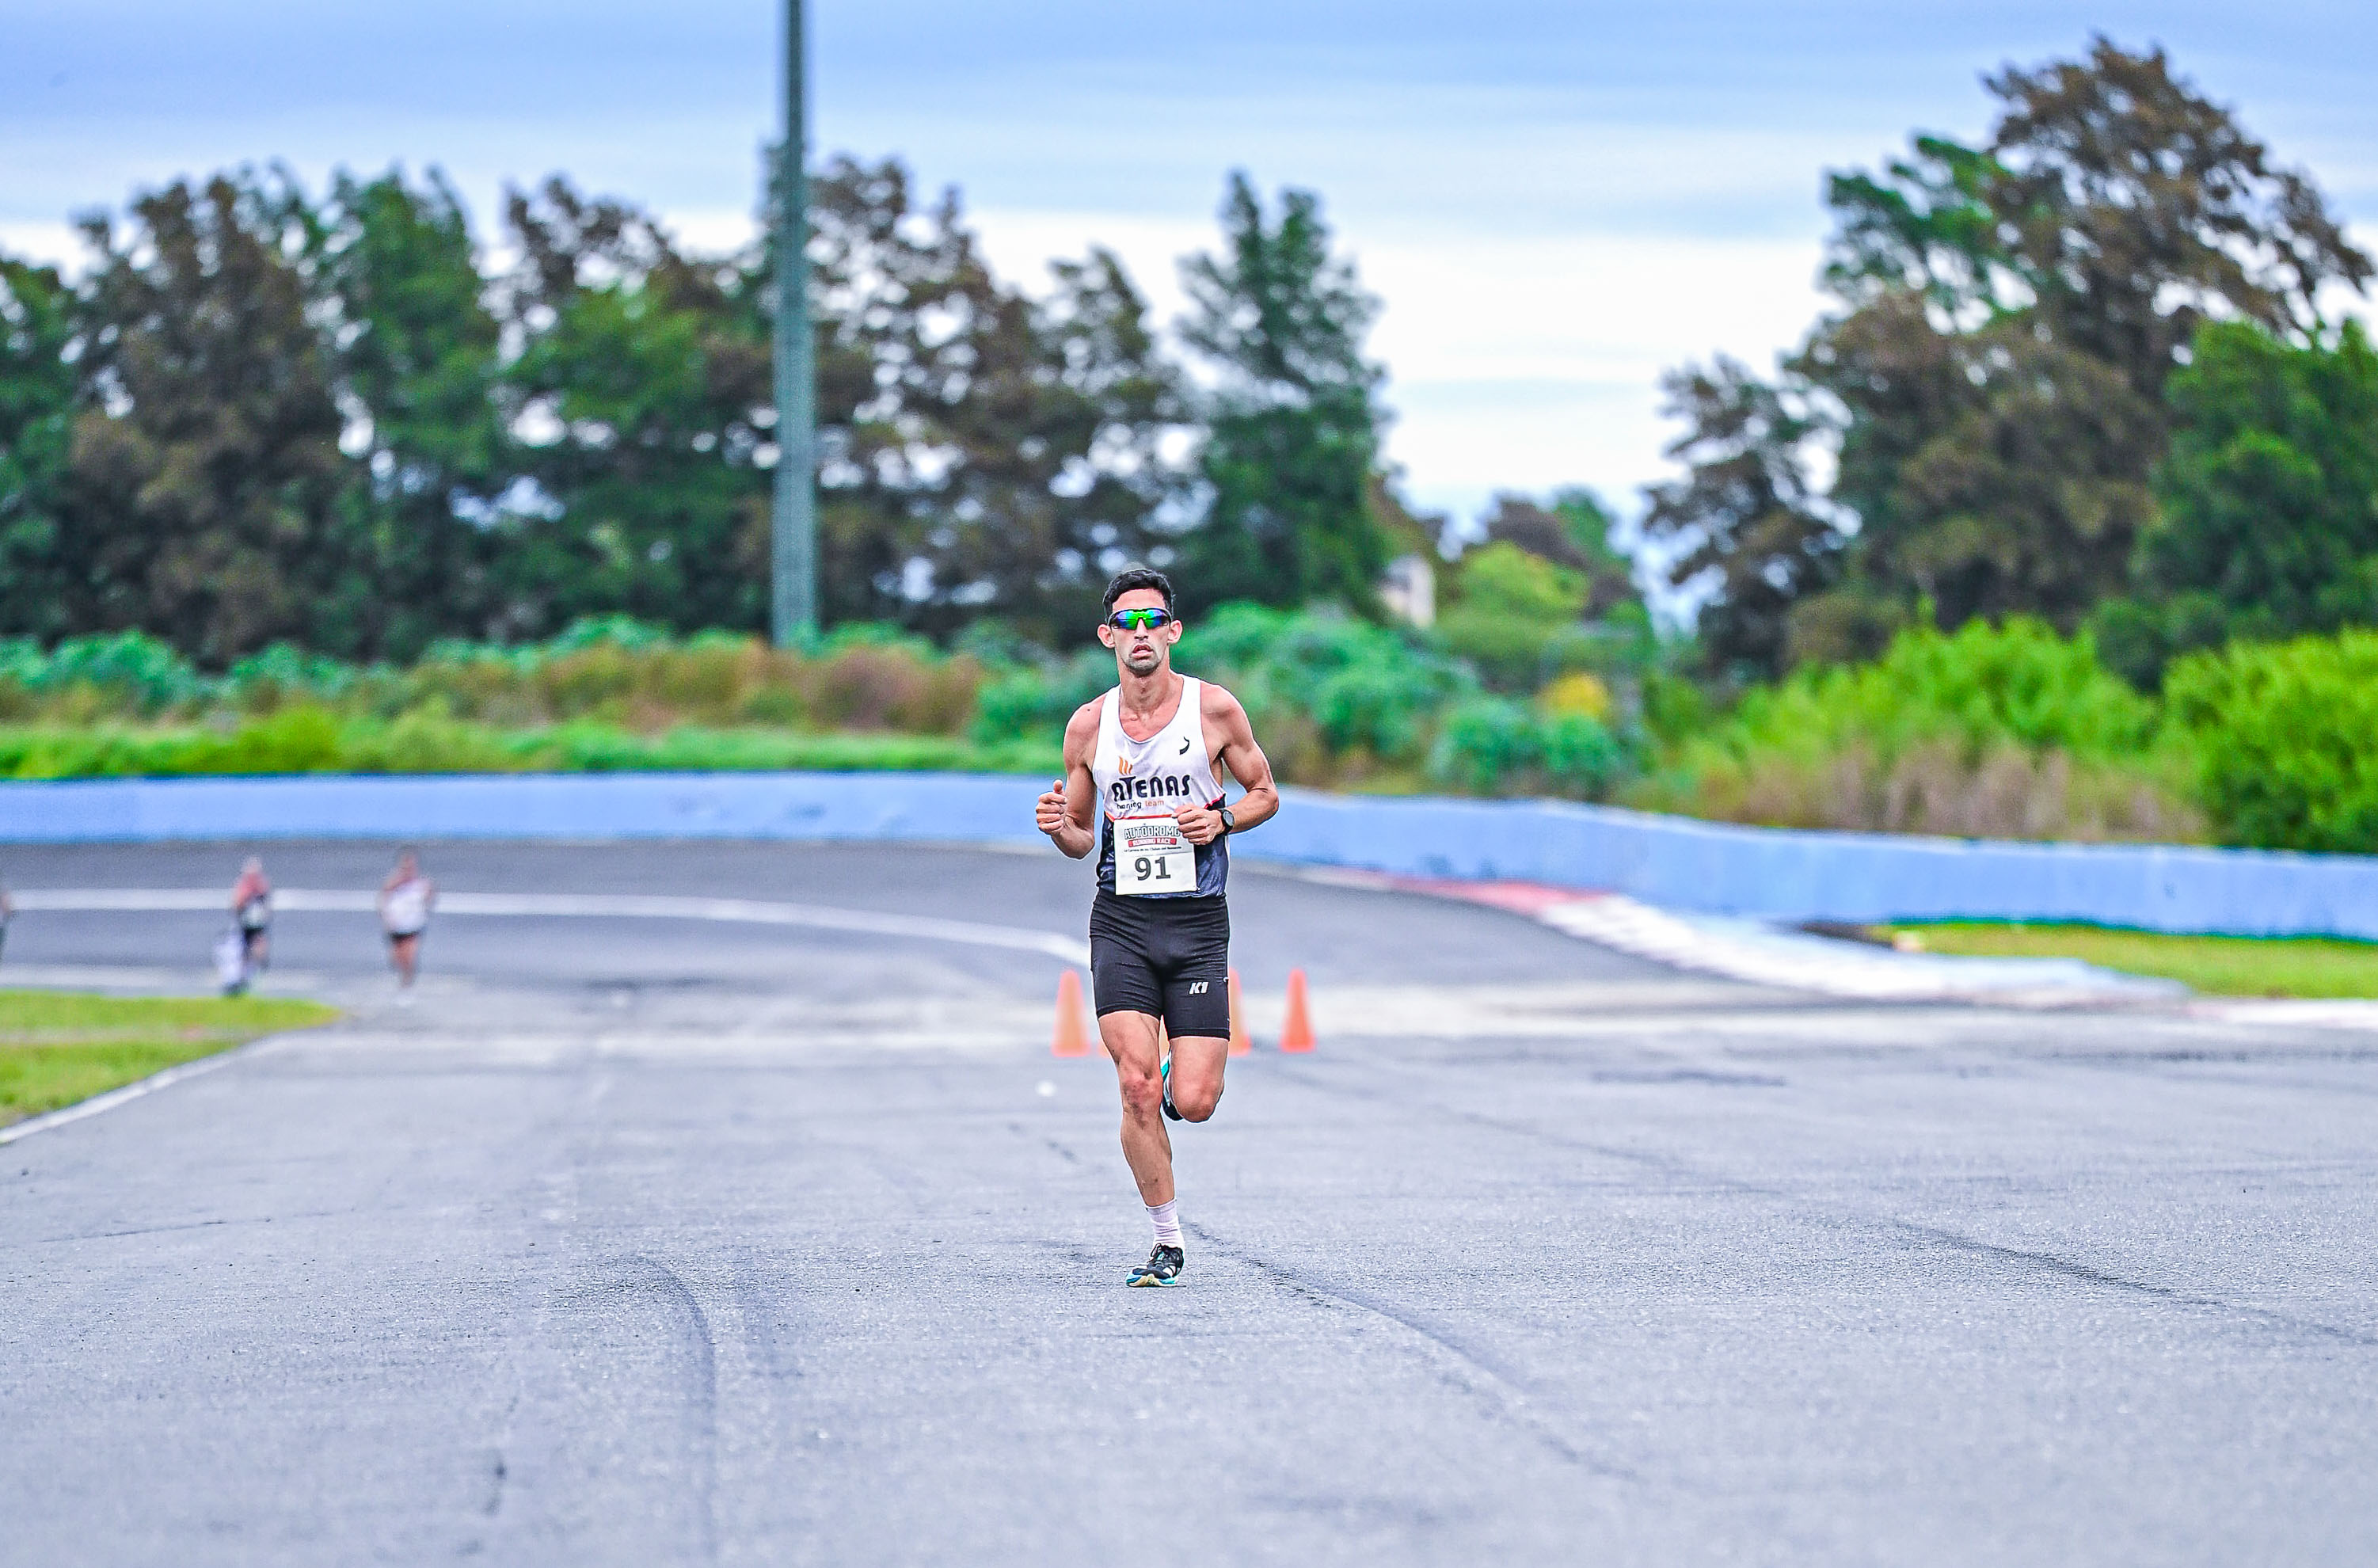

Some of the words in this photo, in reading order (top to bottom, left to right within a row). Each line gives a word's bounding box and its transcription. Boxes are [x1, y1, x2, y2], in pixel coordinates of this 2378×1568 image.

[1111, 774, 1190, 801] ATENAS
[1145, 799, 1165, 808] team
[1134, 856, 1171, 881] 91
